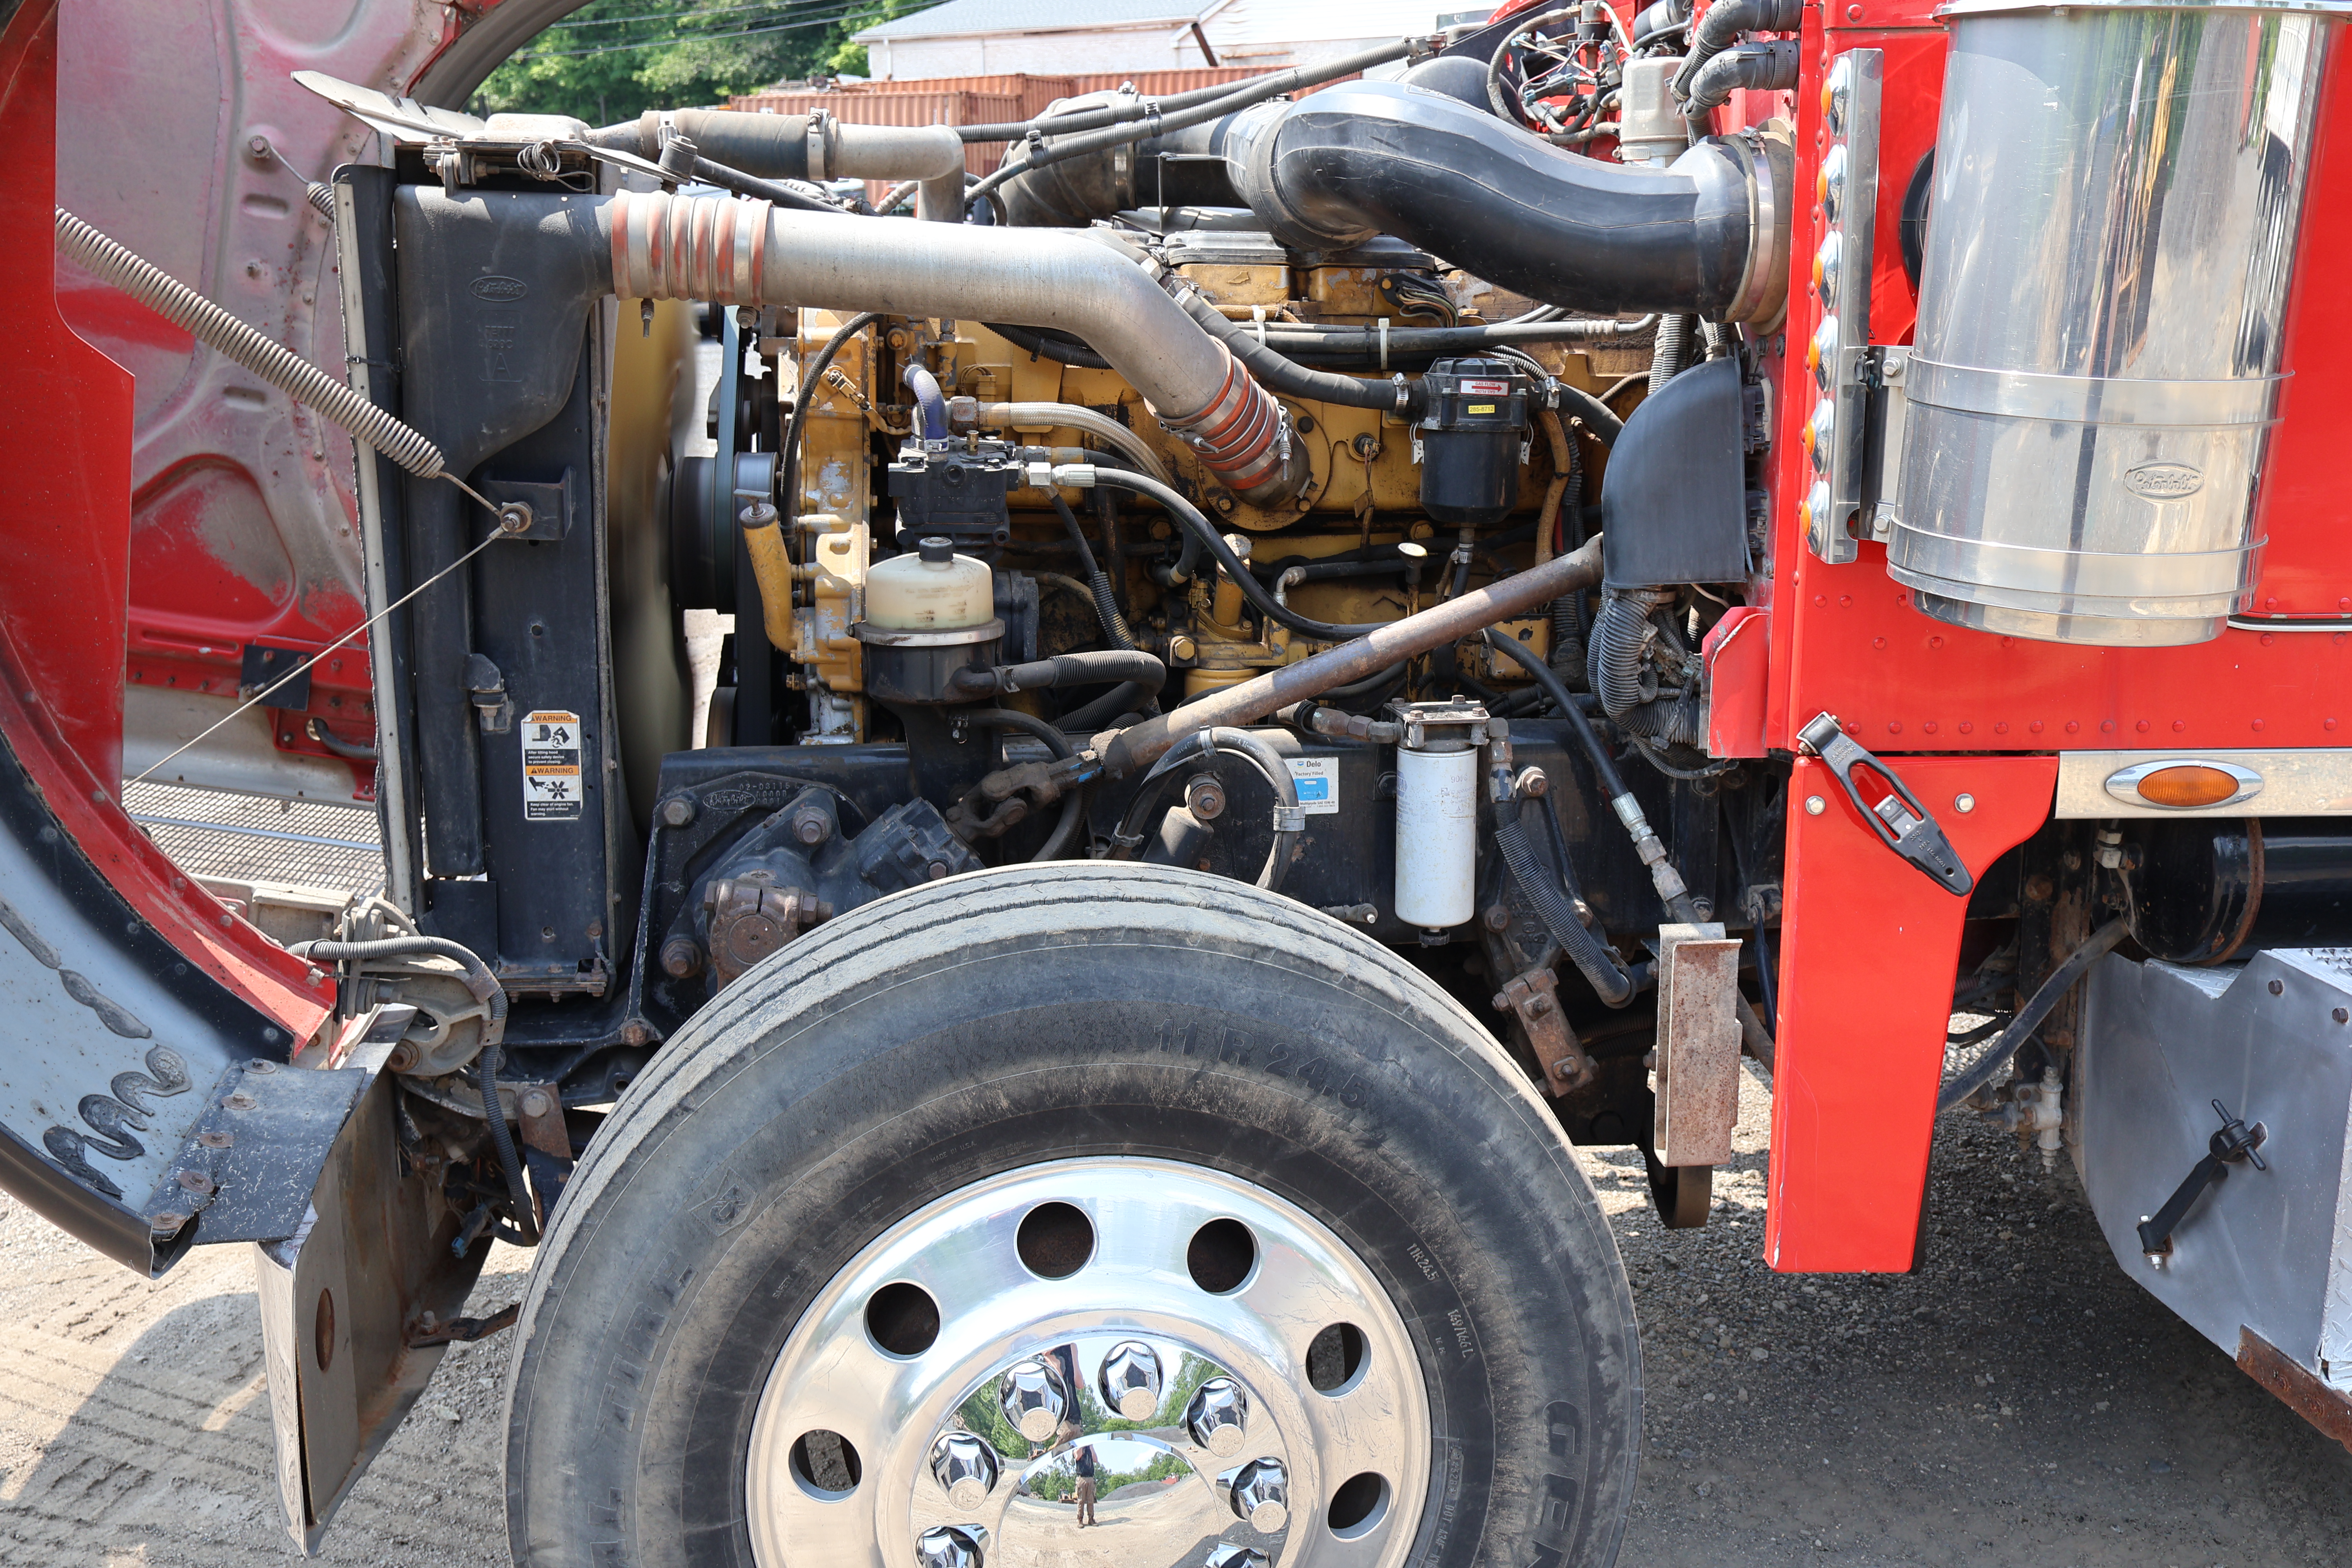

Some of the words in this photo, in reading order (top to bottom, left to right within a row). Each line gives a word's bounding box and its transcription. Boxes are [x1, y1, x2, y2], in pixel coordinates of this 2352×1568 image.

[2134, 470, 2198, 490] Peterbilt
[1154, 1019, 1198, 1056] 11
[1218, 1027, 1255, 1067] R
[1263, 1043, 1372, 1109] 24.5
[931, 1152, 948, 1163] MADE
[960, 1141, 977, 1151] U.S.A.
[1407, 1243, 1439, 1281] 11R24.5
[772, 1275, 793, 1299] SAFETY
